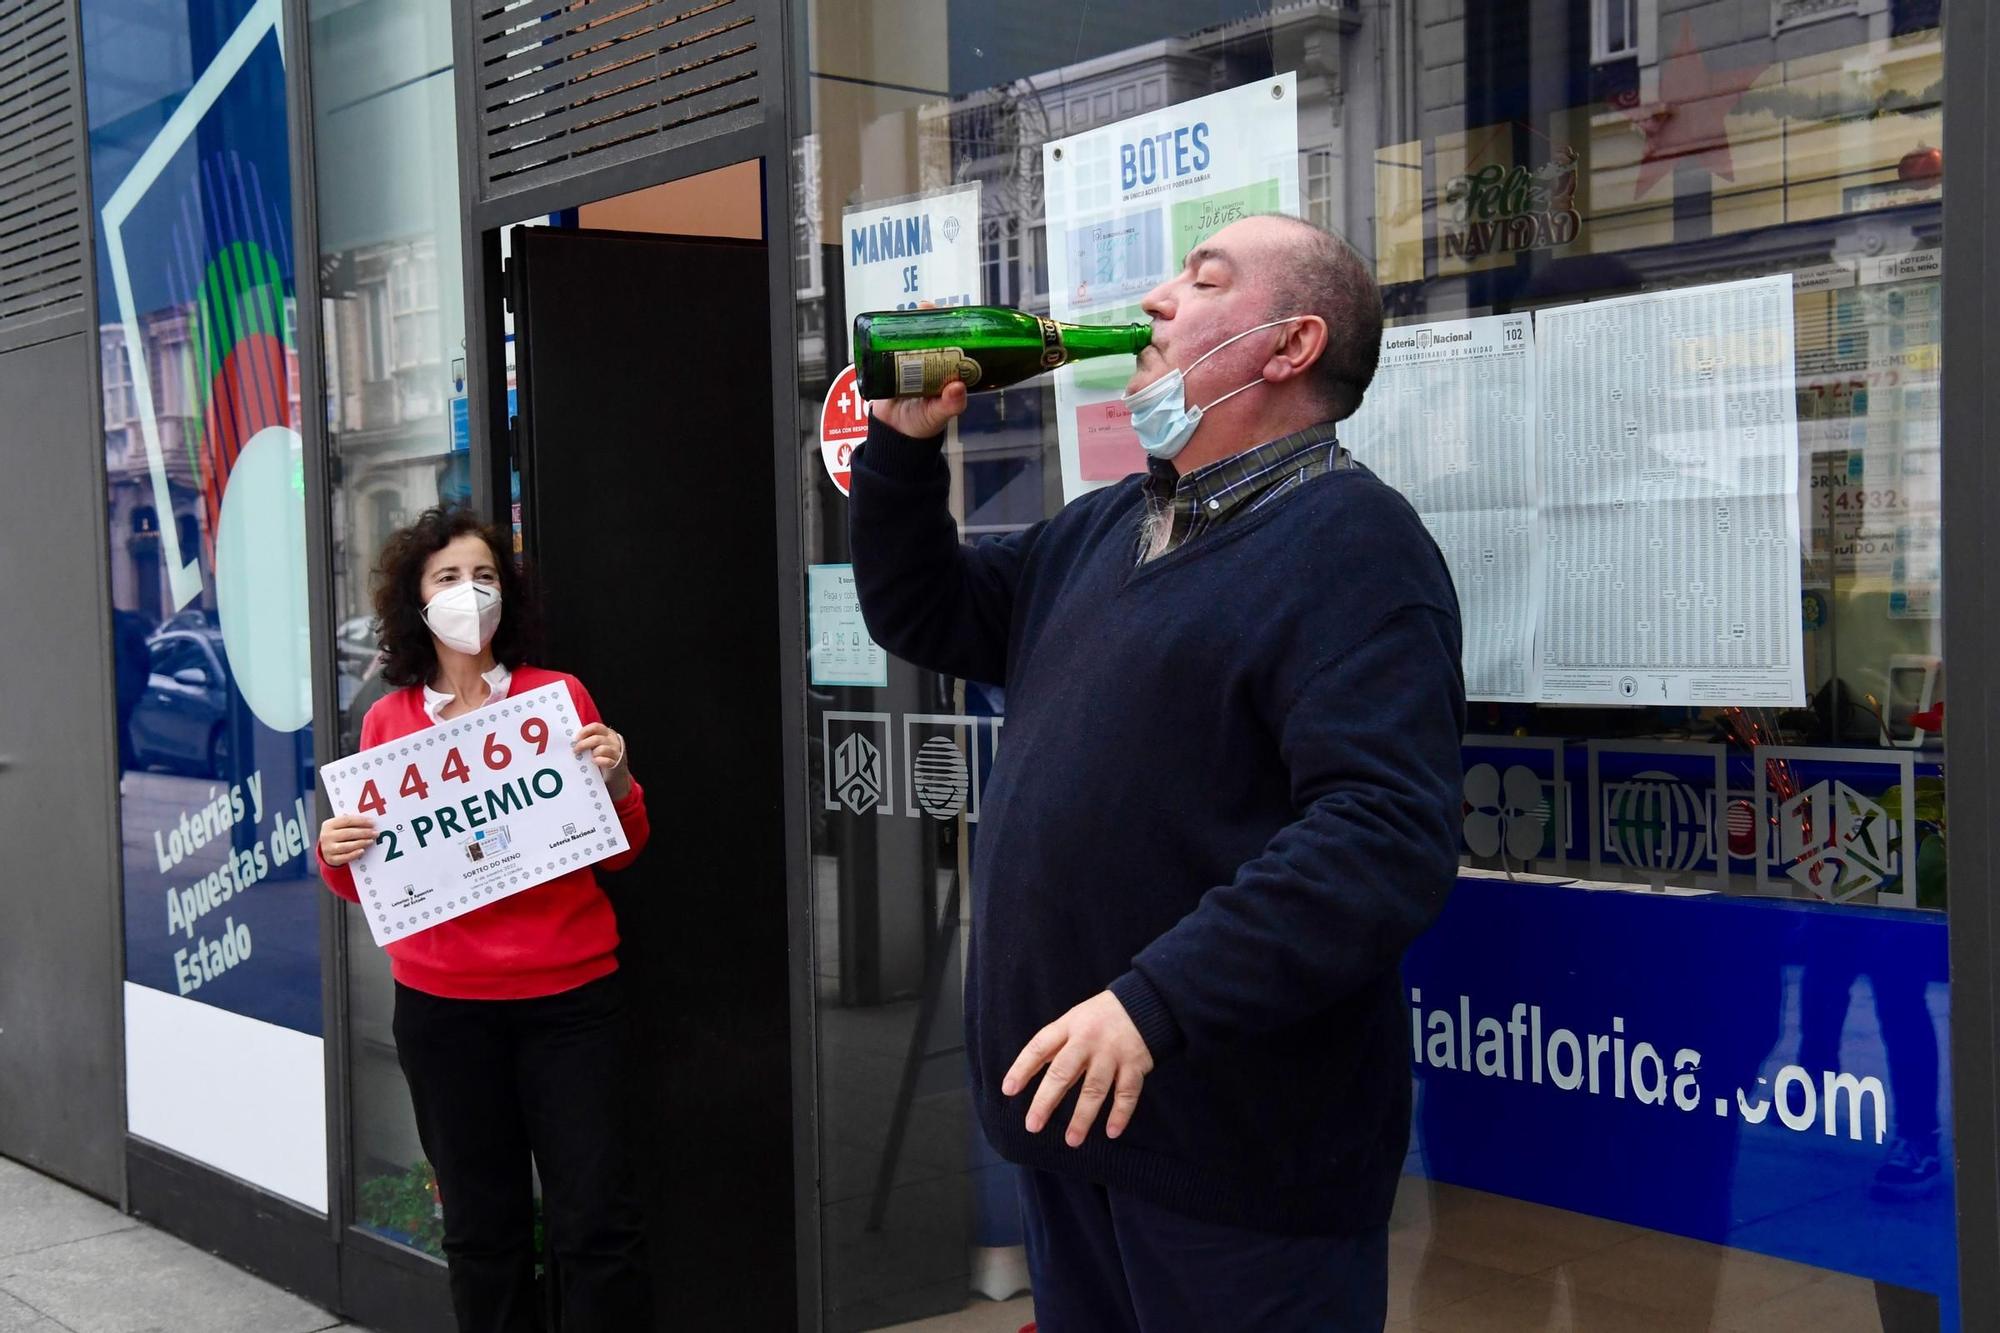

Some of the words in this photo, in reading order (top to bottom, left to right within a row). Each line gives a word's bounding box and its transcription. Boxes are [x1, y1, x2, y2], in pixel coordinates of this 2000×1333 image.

[1120, 122, 1210, 191] BOTES
[1464, 164, 1550, 220] Feliz
[851, 214, 934, 267] MAÑANA
[1445, 209, 1581, 260] NAVIDAD
[903, 265, 919, 293] SE
[1900, 254, 1935, 266] LOTERÍA
[1900, 266, 1915, 274] DEL
[1917, 262, 1939, 272] NIÑO
[1394, 350, 1447, 363] EXTRAORDINARIO
[1464, 345, 1494, 355] NAVIDAD
[1433, 331, 1473, 345] Nacional
[1506, 328, 1523, 341] 102
[154, 784, 245, 874] Loterías
[247, 770, 264, 824] y
[411, 768, 563, 848] PREMIO
[571, 827, 596, 840] Nacional
[167, 842, 268, 939] Apuestas
[270, 797, 310, 867] del
[463, 865, 489, 879] SORTEO
[490, 860, 501, 869] DO
[174, 916, 252, 996] Estado
